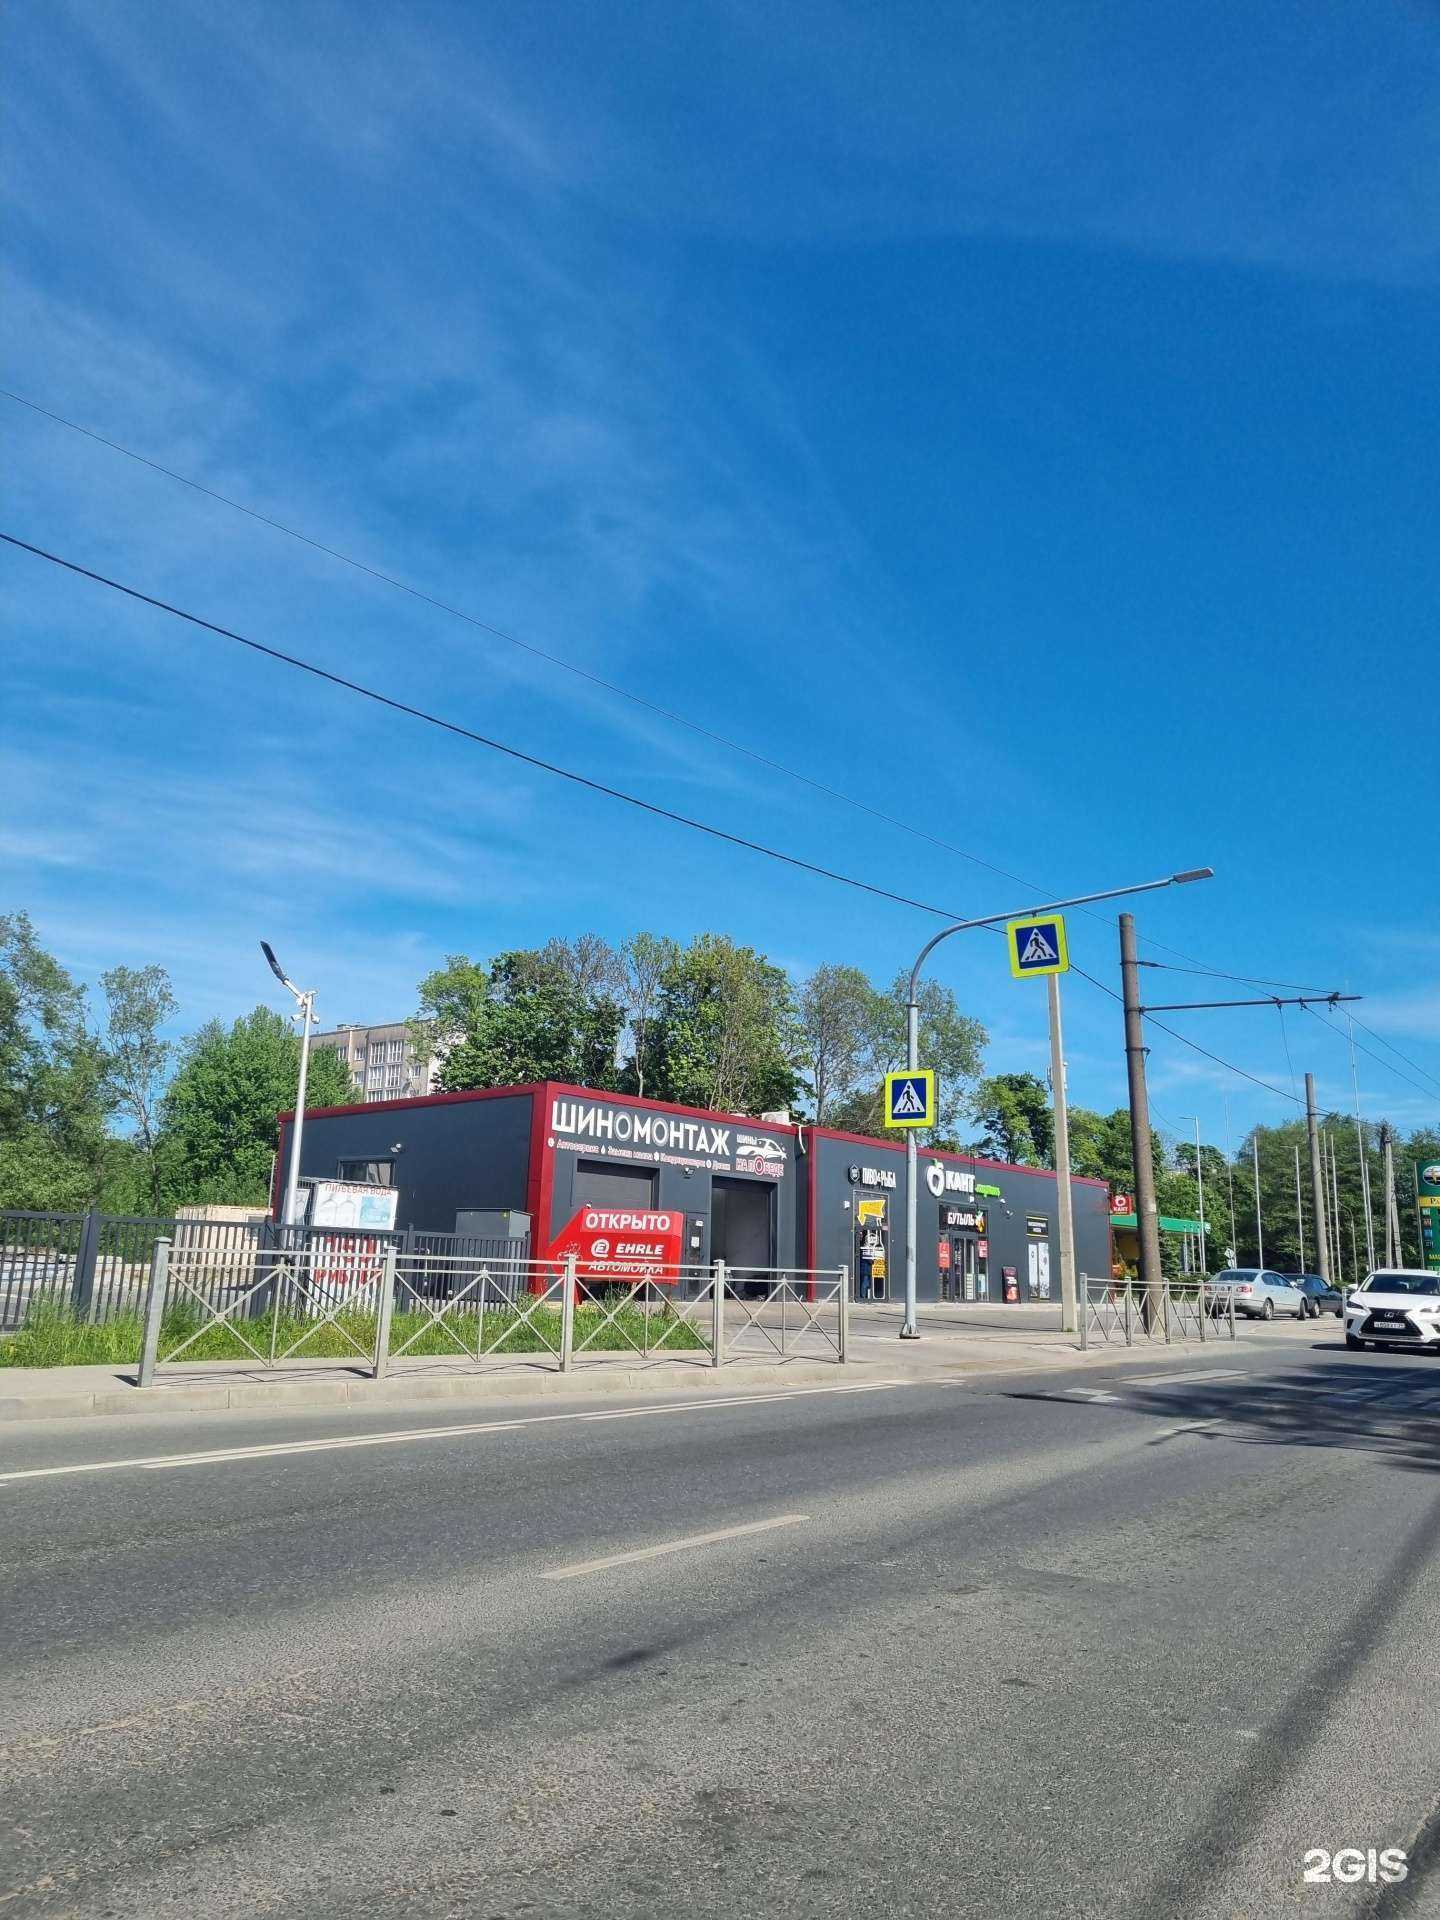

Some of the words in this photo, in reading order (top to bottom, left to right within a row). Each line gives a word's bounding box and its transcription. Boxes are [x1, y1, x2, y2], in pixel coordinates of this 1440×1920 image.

[551, 1100, 731, 1156] ШИНОМОНТАЖ
[945, 1170, 976, 1193] КАНТ
[585, 1212, 671, 1231] ОТКРЫТО
[615, 1243, 664, 1255] EHRLE
